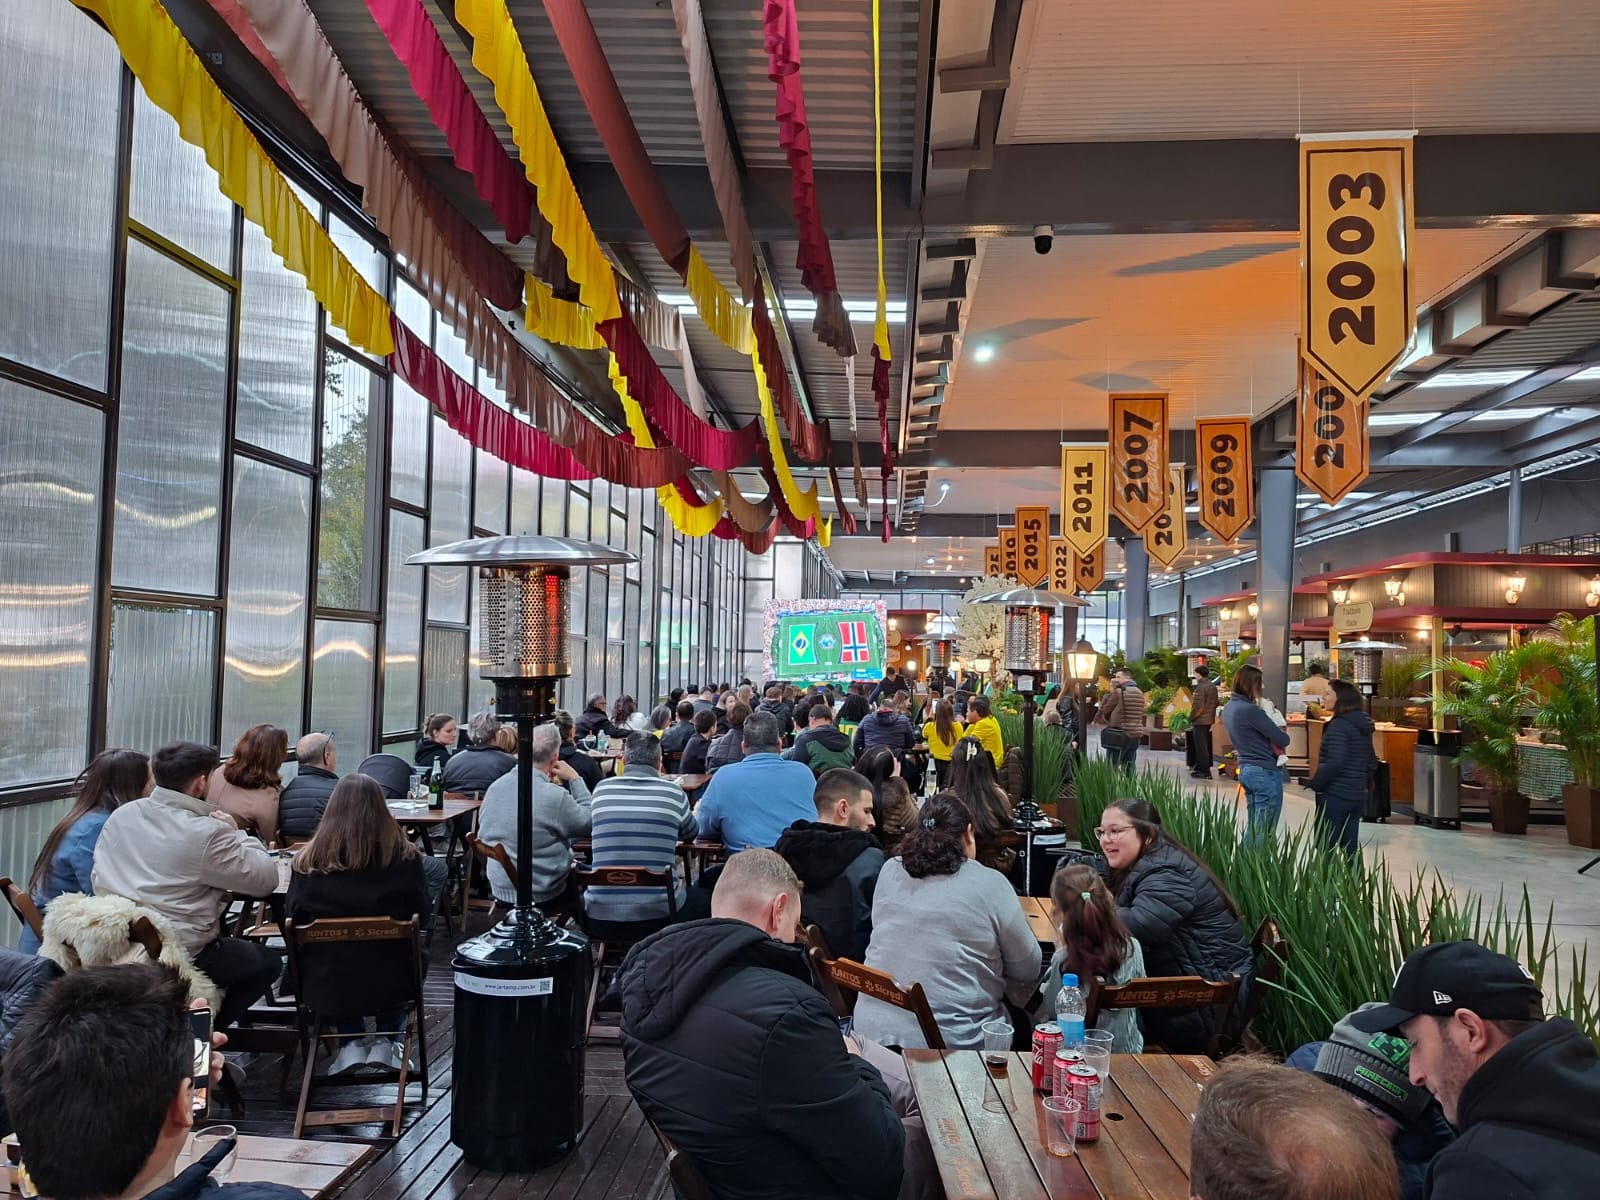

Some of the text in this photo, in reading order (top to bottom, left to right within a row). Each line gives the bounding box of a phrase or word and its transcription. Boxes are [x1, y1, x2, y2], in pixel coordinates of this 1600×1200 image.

[1326, 172, 1386, 346] 2003
[1313, 370, 1345, 469] 200
[1123, 409, 1154, 504] 2007
[1210, 434, 1238, 518] 2009
[1072, 462, 1093, 533] 2011
[1024, 519, 1041, 571] 2015
[1055, 546, 1067, 589] 2022
[1081, 553, 1094, 578] 20
[367, 927, 399, 936] Sicredi
[831, 966, 904, 1002] JUNTOS Sicredi
[1114, 989, 1214, 1001] JUNTOS Sicredi
